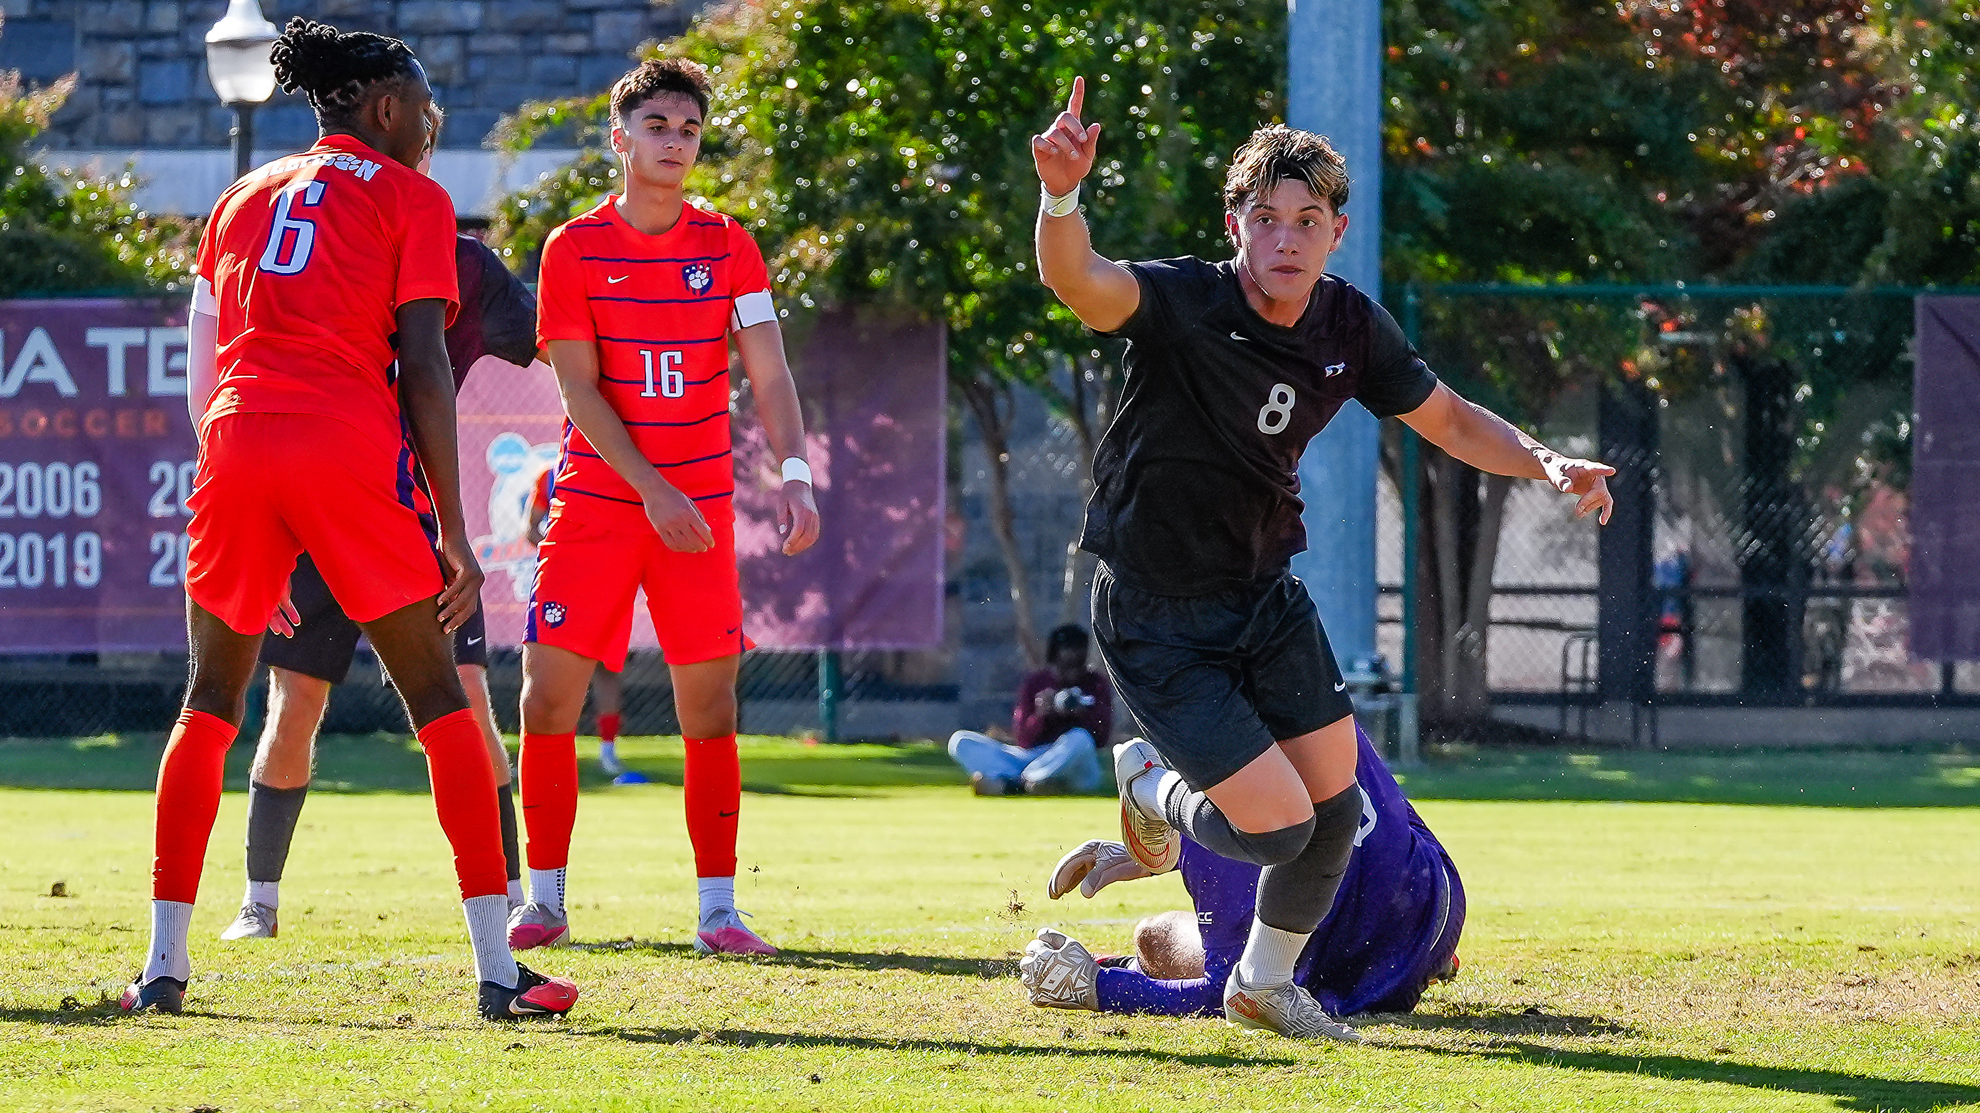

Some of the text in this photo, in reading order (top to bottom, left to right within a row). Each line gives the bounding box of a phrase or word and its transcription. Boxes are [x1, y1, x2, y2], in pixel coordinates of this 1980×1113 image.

[259, 180, 329, 276] 6
[0, 326, 79, 398] A
[639, 349, 685, 399] 16
[1257, 383, 1296, 435] 8
[0, 461, 101, 519] 2006
[0, 531, 101, 589] 2019
